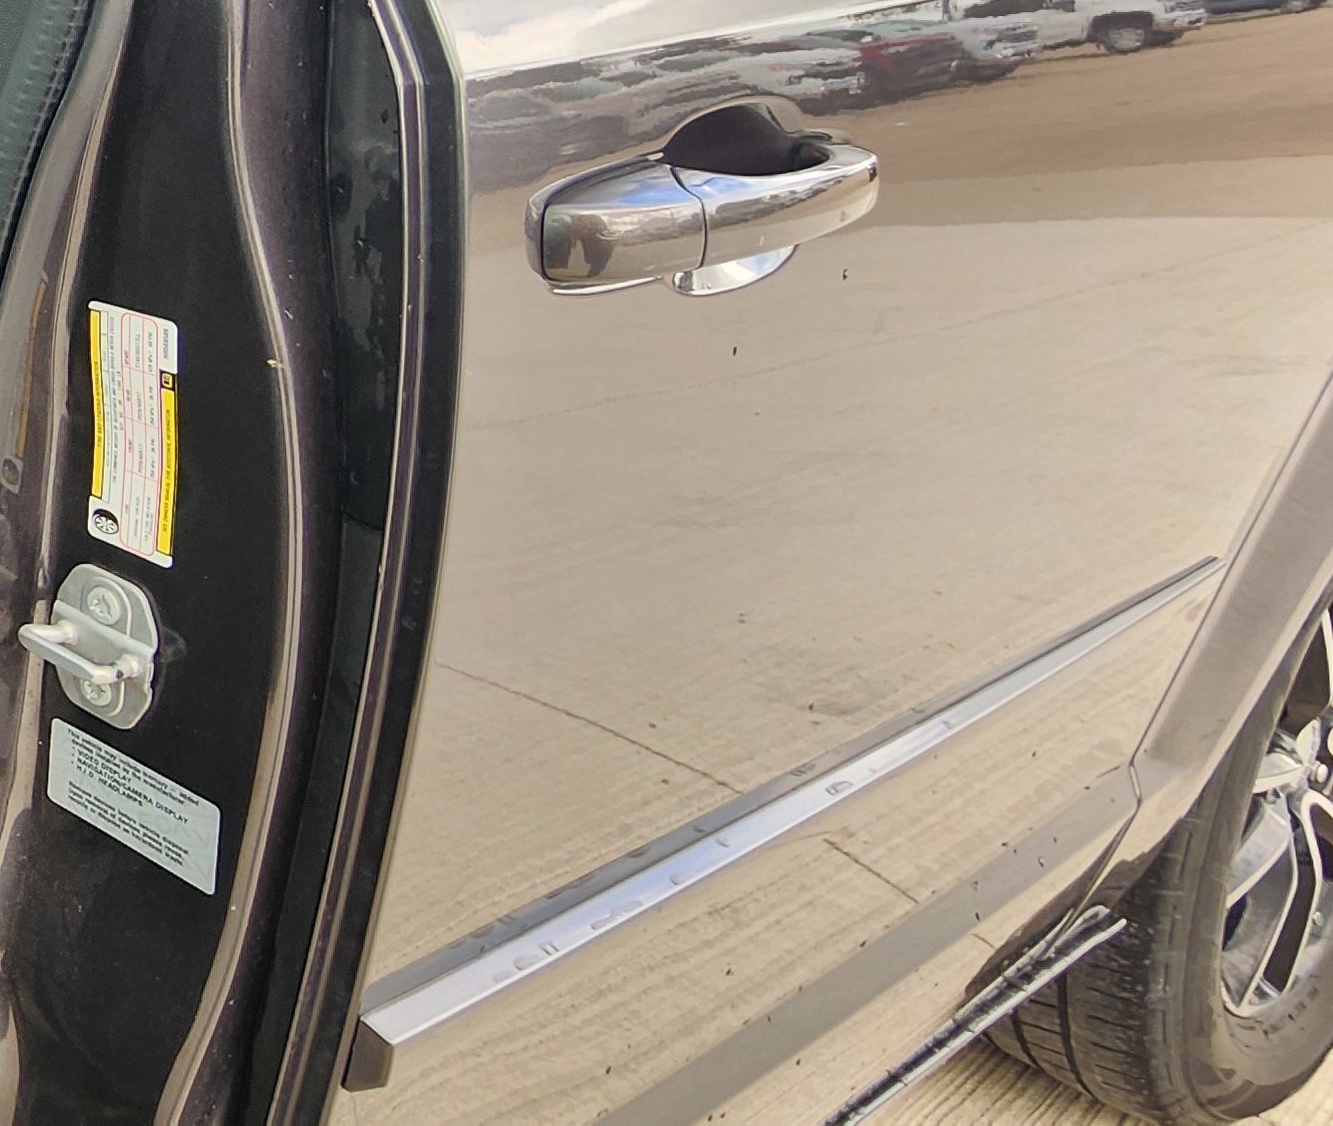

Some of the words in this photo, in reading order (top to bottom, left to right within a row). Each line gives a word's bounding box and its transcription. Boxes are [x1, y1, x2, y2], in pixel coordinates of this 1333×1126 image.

[77, 748, 99, 766] VIDEO
[101, 762, 131, 784] DISPLAY
[155, 800, 187, 825] DISPLAY
